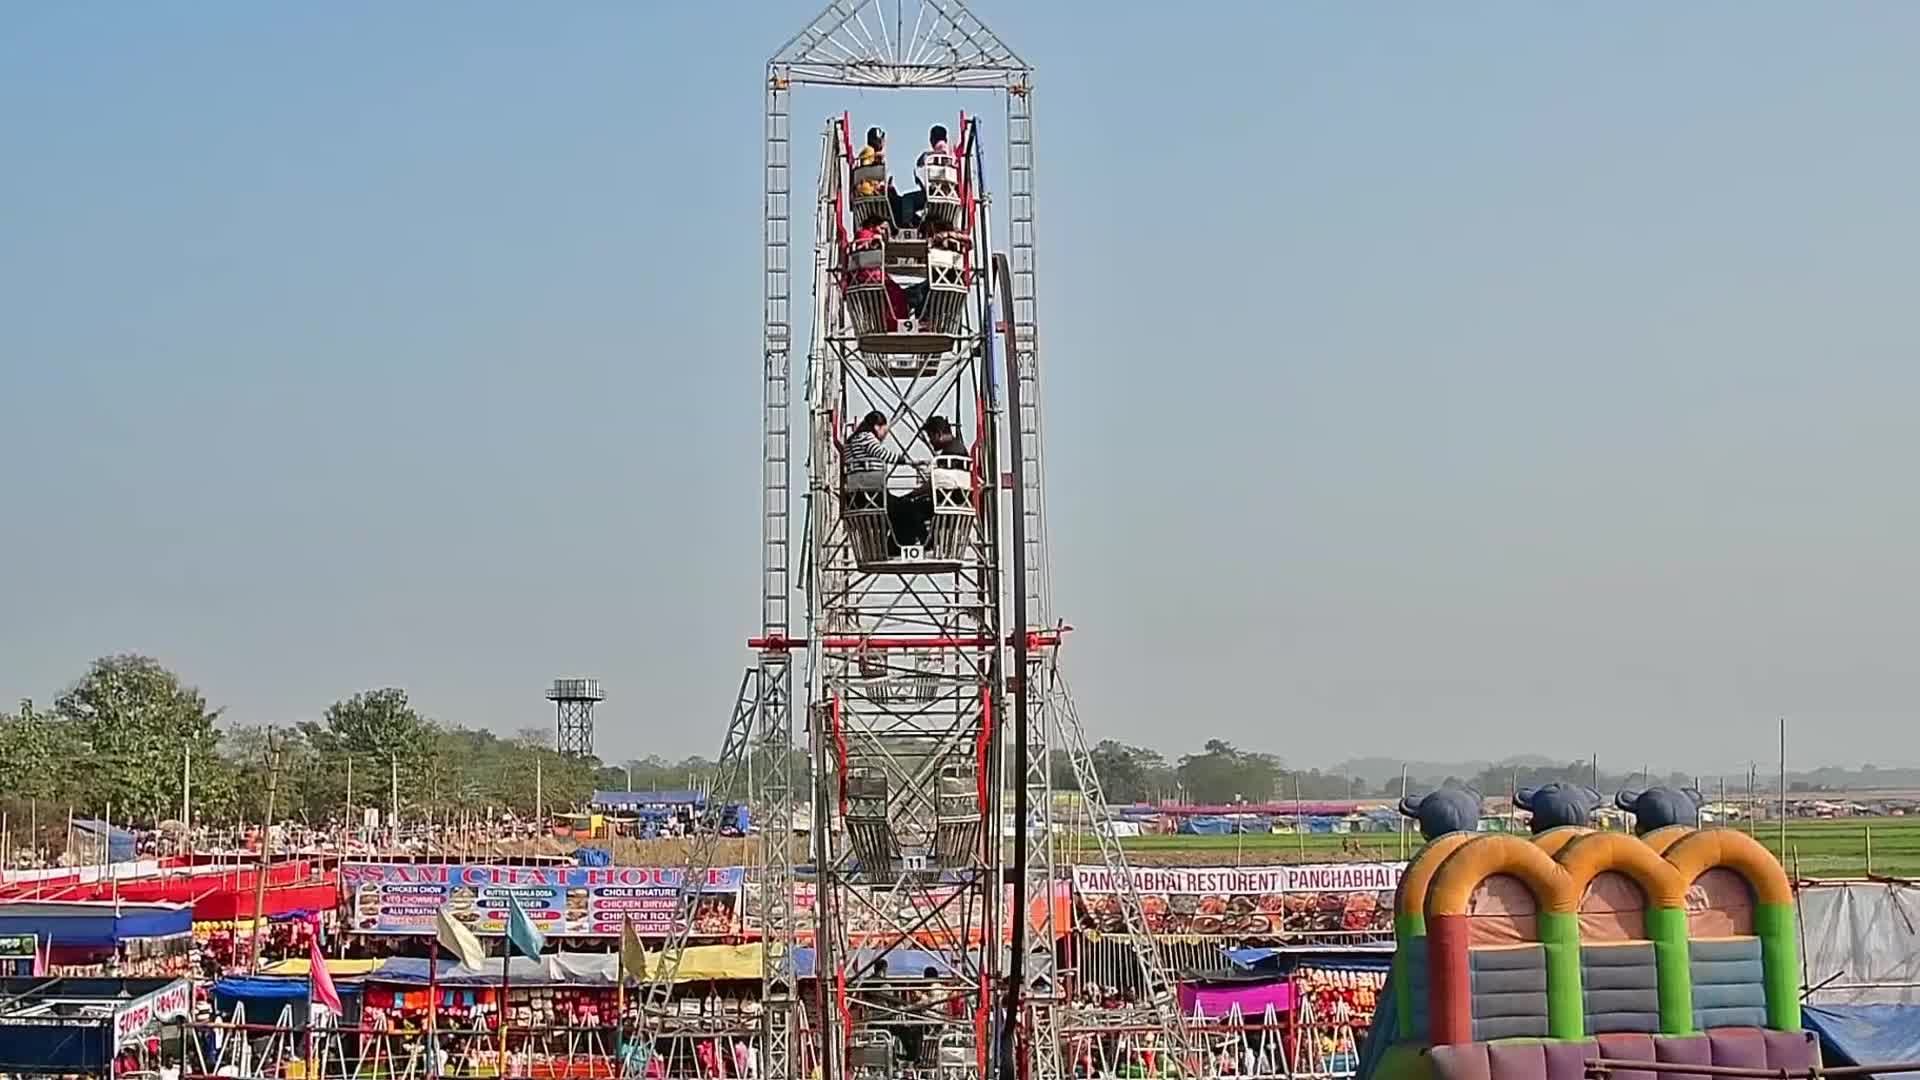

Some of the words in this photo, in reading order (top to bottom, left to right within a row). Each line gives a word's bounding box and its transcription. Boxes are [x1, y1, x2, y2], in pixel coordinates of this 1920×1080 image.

[903, 320, 913, 332] 9
[903, 548, 920, 559] 10
[909, 858, 921, 868] 11
[461, 866, 577, 886] CHAT
[584, 867, 731, 887] HOUE
[1187, 872, 1278, 892] RESTURENT
[1288, 869, 1390, 889] PANCHABHAI
[602, 888, 634, 897] CHOLE
[600, 900, 641, 909] CHICKEN
[119, 1005, 149, 1039] SUPER
